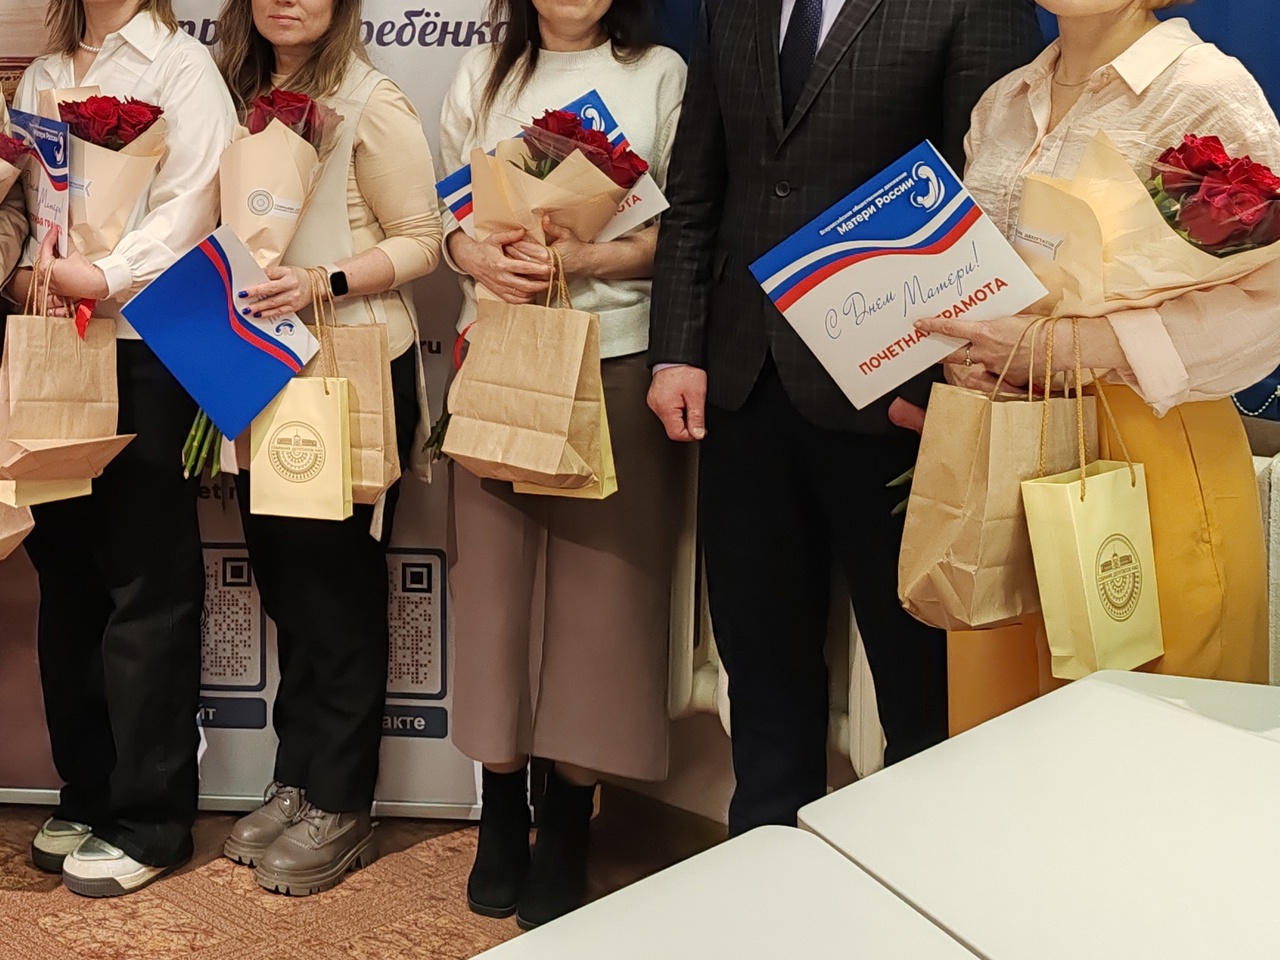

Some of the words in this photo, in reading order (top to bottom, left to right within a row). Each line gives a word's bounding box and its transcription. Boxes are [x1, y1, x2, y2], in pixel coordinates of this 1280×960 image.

[836, 204, 877, 235] Матери
[874, 178, 915, 208] России
[824, 308, 842, 340] С
[903, 240, 980, 318] Матери!
[858, 329, 931, 376] ПОЧЕТНА
[382, 716, 426, 731] акте
